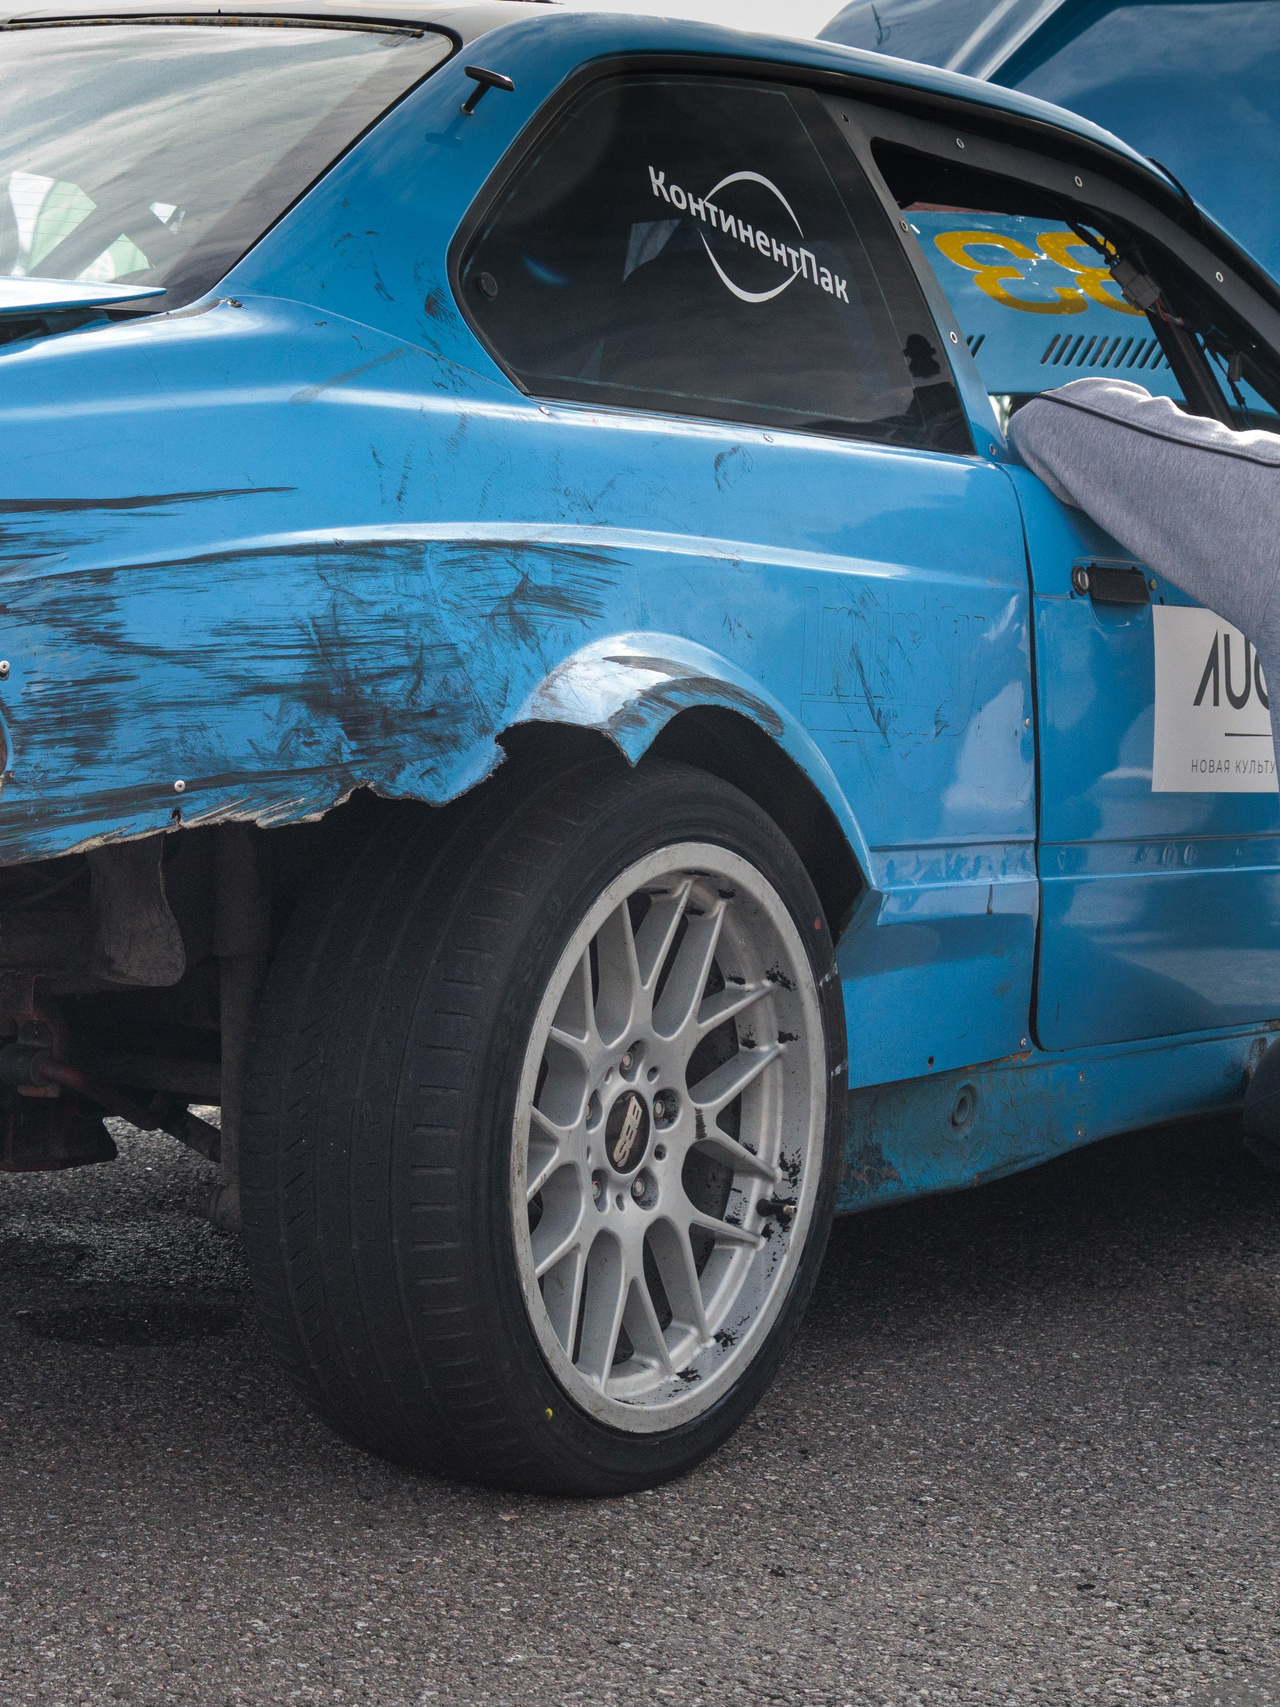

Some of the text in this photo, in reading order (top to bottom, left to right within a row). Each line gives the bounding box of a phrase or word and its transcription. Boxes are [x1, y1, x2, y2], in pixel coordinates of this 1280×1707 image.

[648, 165, 850, 304] КонтинентПак
[1191, 759, 1230, 774] НОВАЯ
[612, 1095, 643, 1168] BBS
